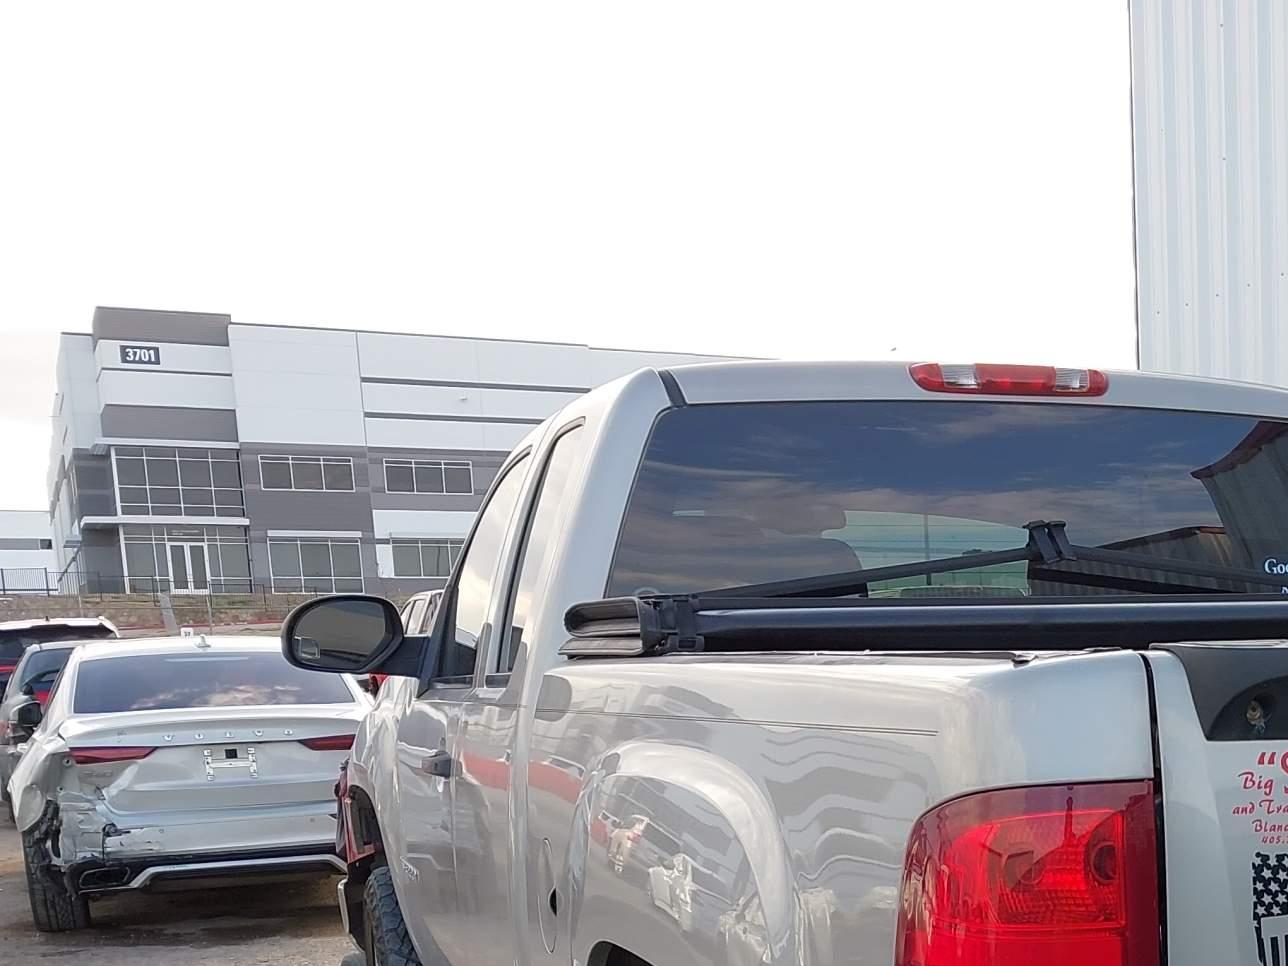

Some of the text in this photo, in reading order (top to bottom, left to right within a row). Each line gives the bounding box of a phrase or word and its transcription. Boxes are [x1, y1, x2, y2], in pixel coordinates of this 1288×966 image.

[125, 348, 156, 362] 3701
[1238, 771, 1274, 797] Big
[1232, 802, 1256, 815] and
